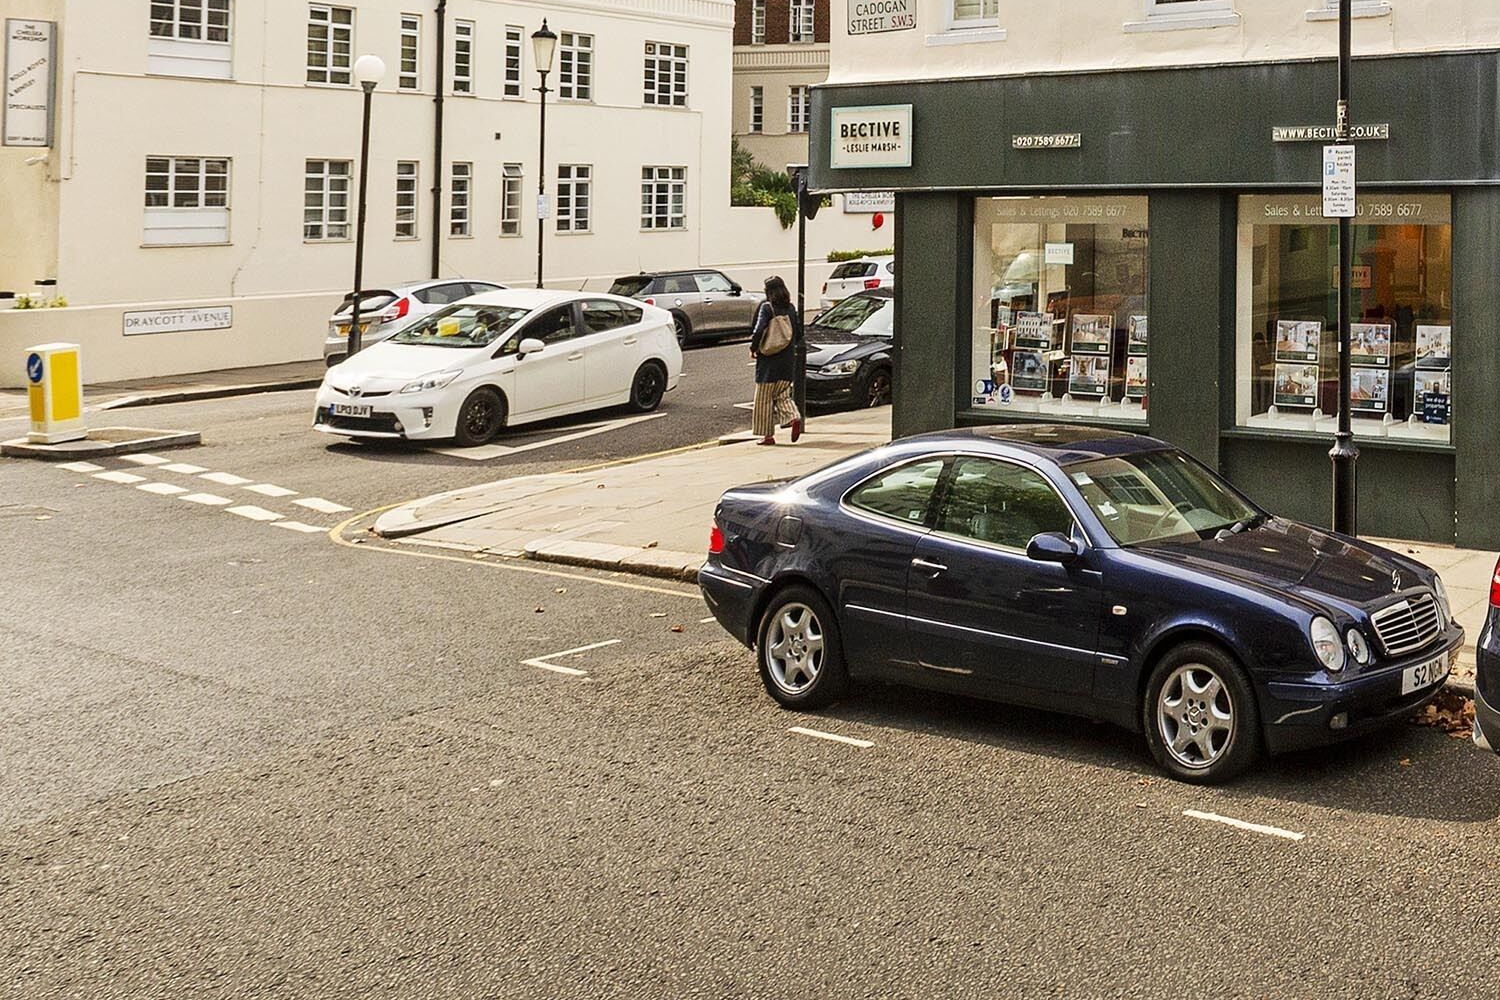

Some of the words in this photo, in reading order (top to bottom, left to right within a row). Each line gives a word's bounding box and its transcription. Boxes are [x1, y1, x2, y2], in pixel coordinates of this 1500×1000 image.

[855, 0, 907, 17] CADOGAN
[840, 121, 900, 138] BECTIVE
[1033, 135, 1054, 146] 7589
[1063, 204, 1078, 217] 020
[1083, 204, 1103, 217] 7589
[1106, 204, 1127, 217] 6677
[1264, 204, 1289, 216] Sales
[1292, 205, 1300, 216] &
[1369, 203, 1393, 216] 7589
[1397, 203, 1422, 216] 6677
[126, 314, 185, 328] DRAYCOTT
[191, 311, 230, 323] AVENUE
[1414, 665, 1427, 687] S2
